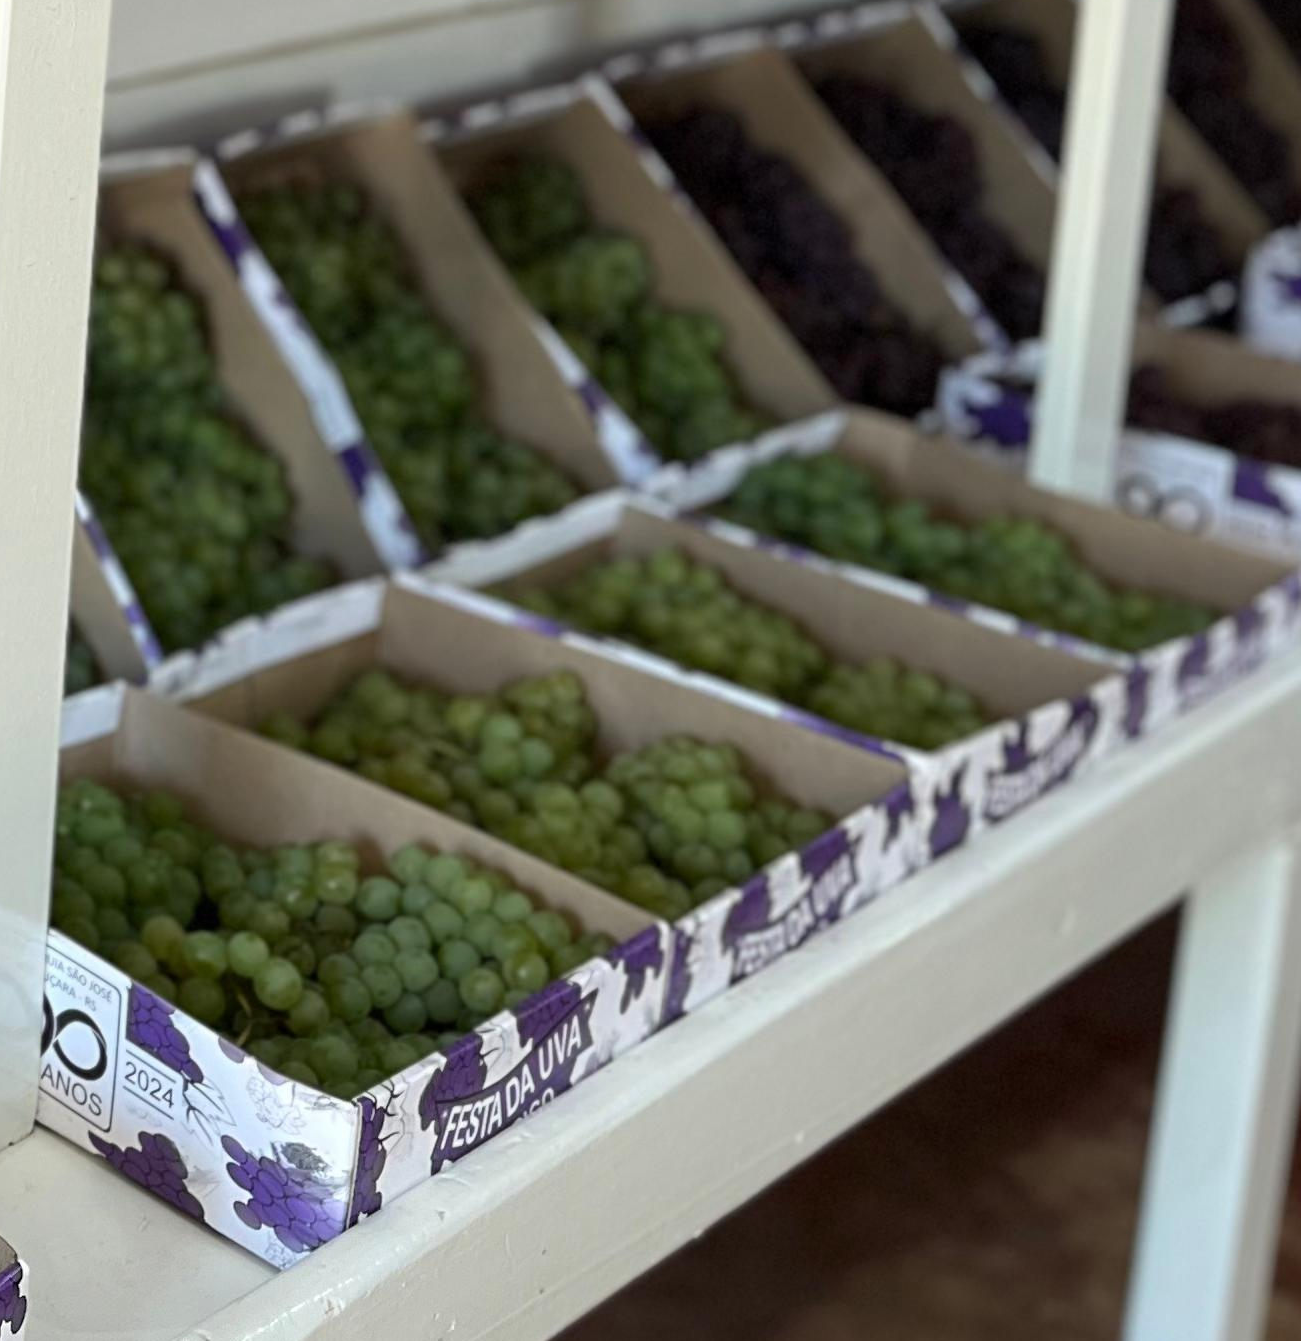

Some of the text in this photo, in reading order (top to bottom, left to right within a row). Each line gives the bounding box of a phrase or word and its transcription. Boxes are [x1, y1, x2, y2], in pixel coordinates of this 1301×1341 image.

[67, 966, 113, 1002] SÃO JOSÉ
[84, 997, 96, 1012] RS
[41, 1063, 103, 1116] ANOS
[124, 1061, 175, 1108] 2024
[440, 1091, 503, 1150] FESTA
[505, 1063, 535, 1118] DA
[538, 1015, 582, 1080] UVA
